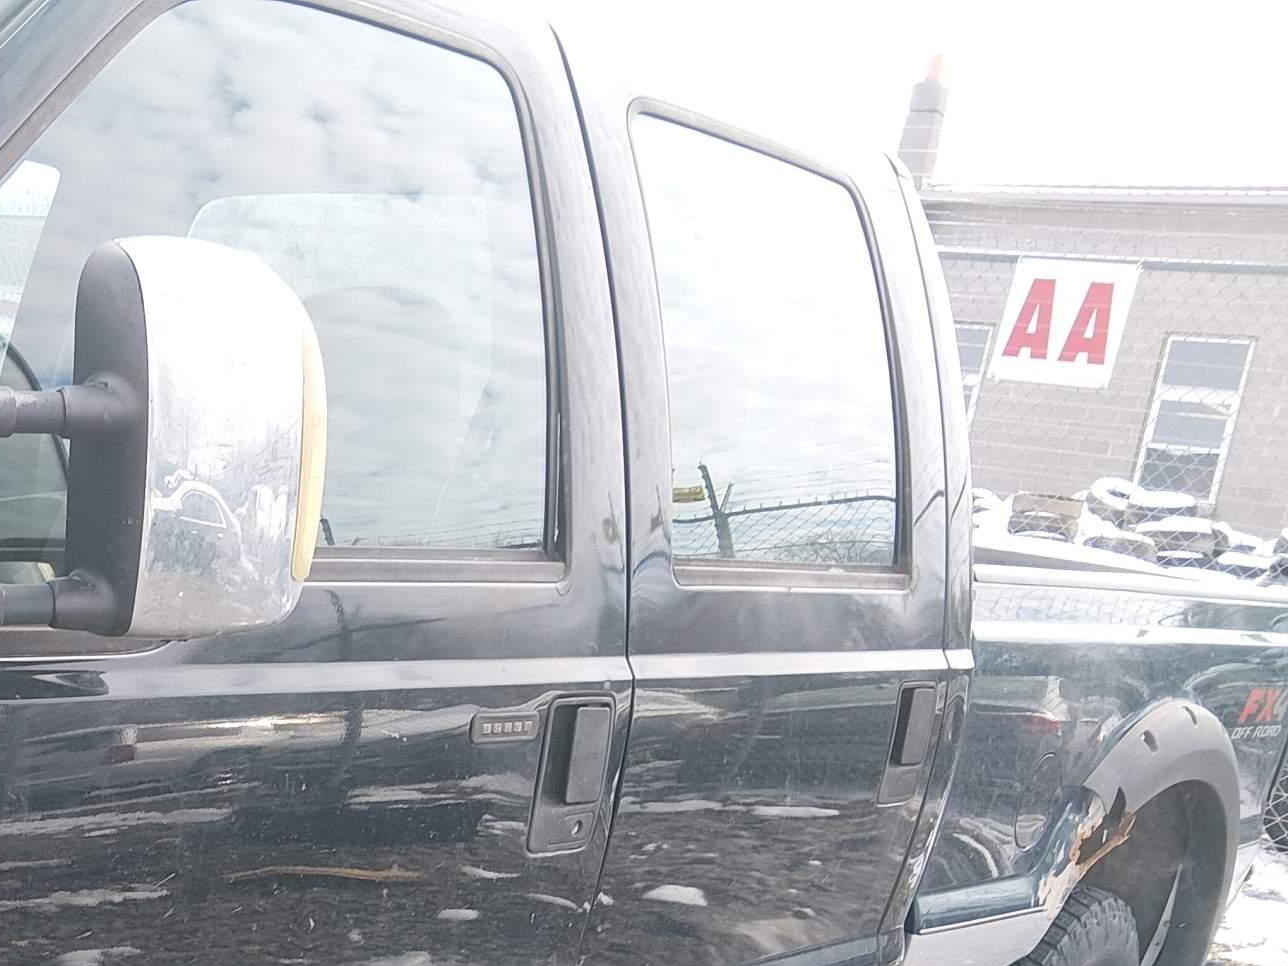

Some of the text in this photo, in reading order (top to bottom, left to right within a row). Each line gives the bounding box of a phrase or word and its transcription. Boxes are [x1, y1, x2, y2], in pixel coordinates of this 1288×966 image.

[1001, 278, 1114, 365] AA
[1231, 725, 1282, 739] OFF ROAD
